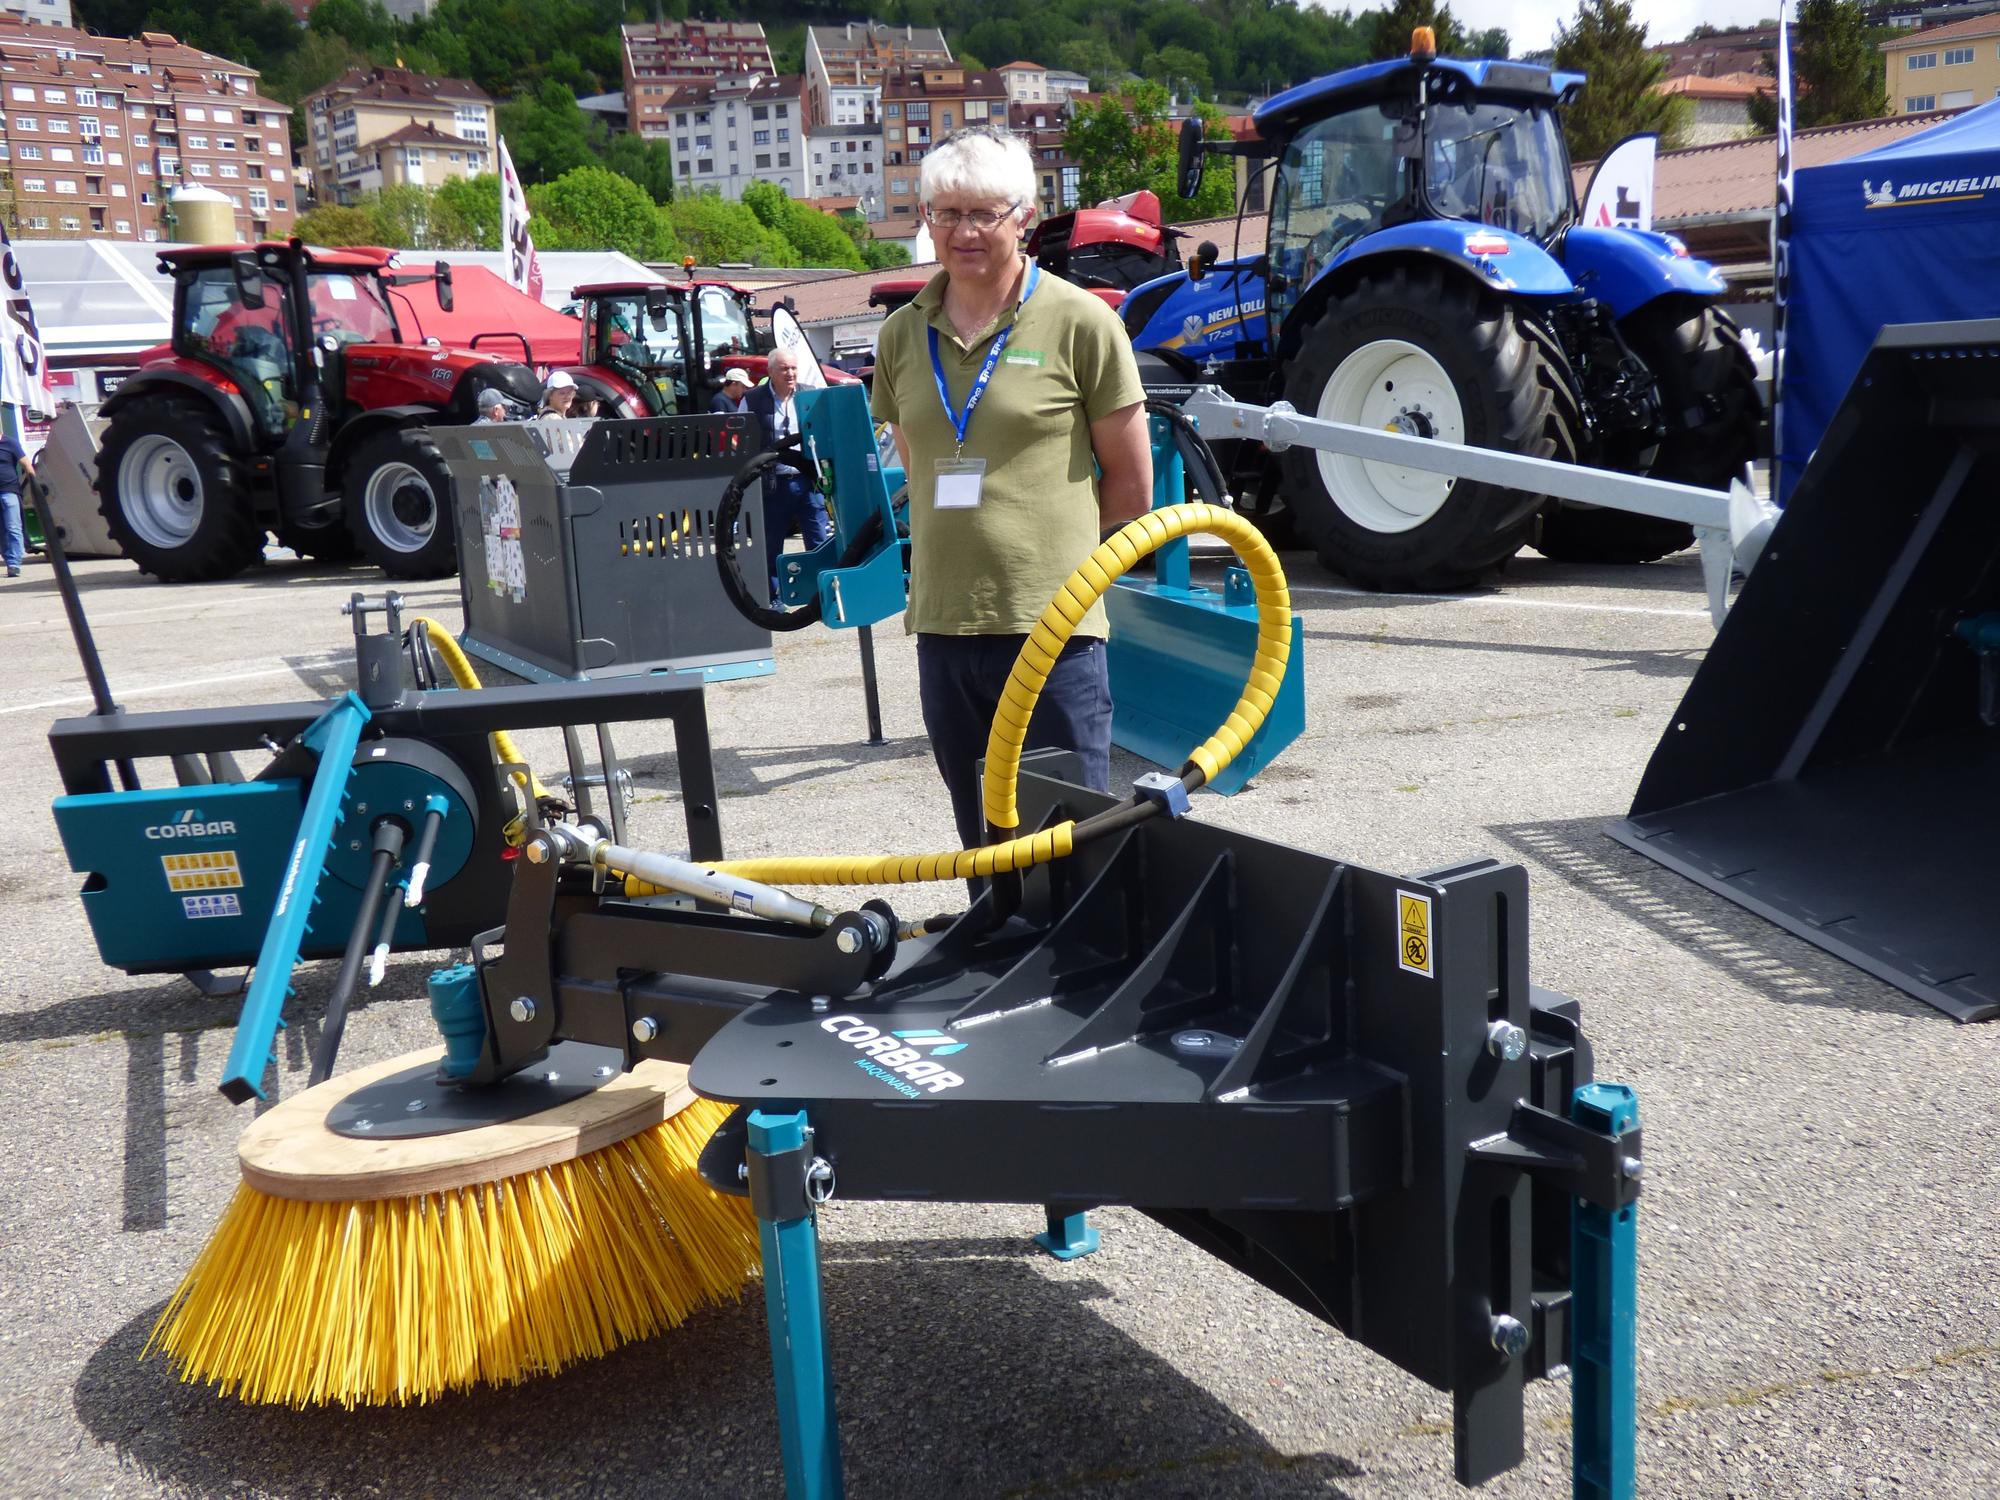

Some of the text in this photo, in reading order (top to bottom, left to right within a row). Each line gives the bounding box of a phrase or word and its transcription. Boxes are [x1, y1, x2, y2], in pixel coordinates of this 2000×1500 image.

[1898, 175, 2000, 198] MICHELIN
[1208, 306, 1233, 323] NEW
[432, 368, 453, 380] 150
[145, 820, 236, 839] CORBAR
[820, 1015, 965, 1093] CORBAR
[854, 1058, 921, 1099] MAQUINARIA
